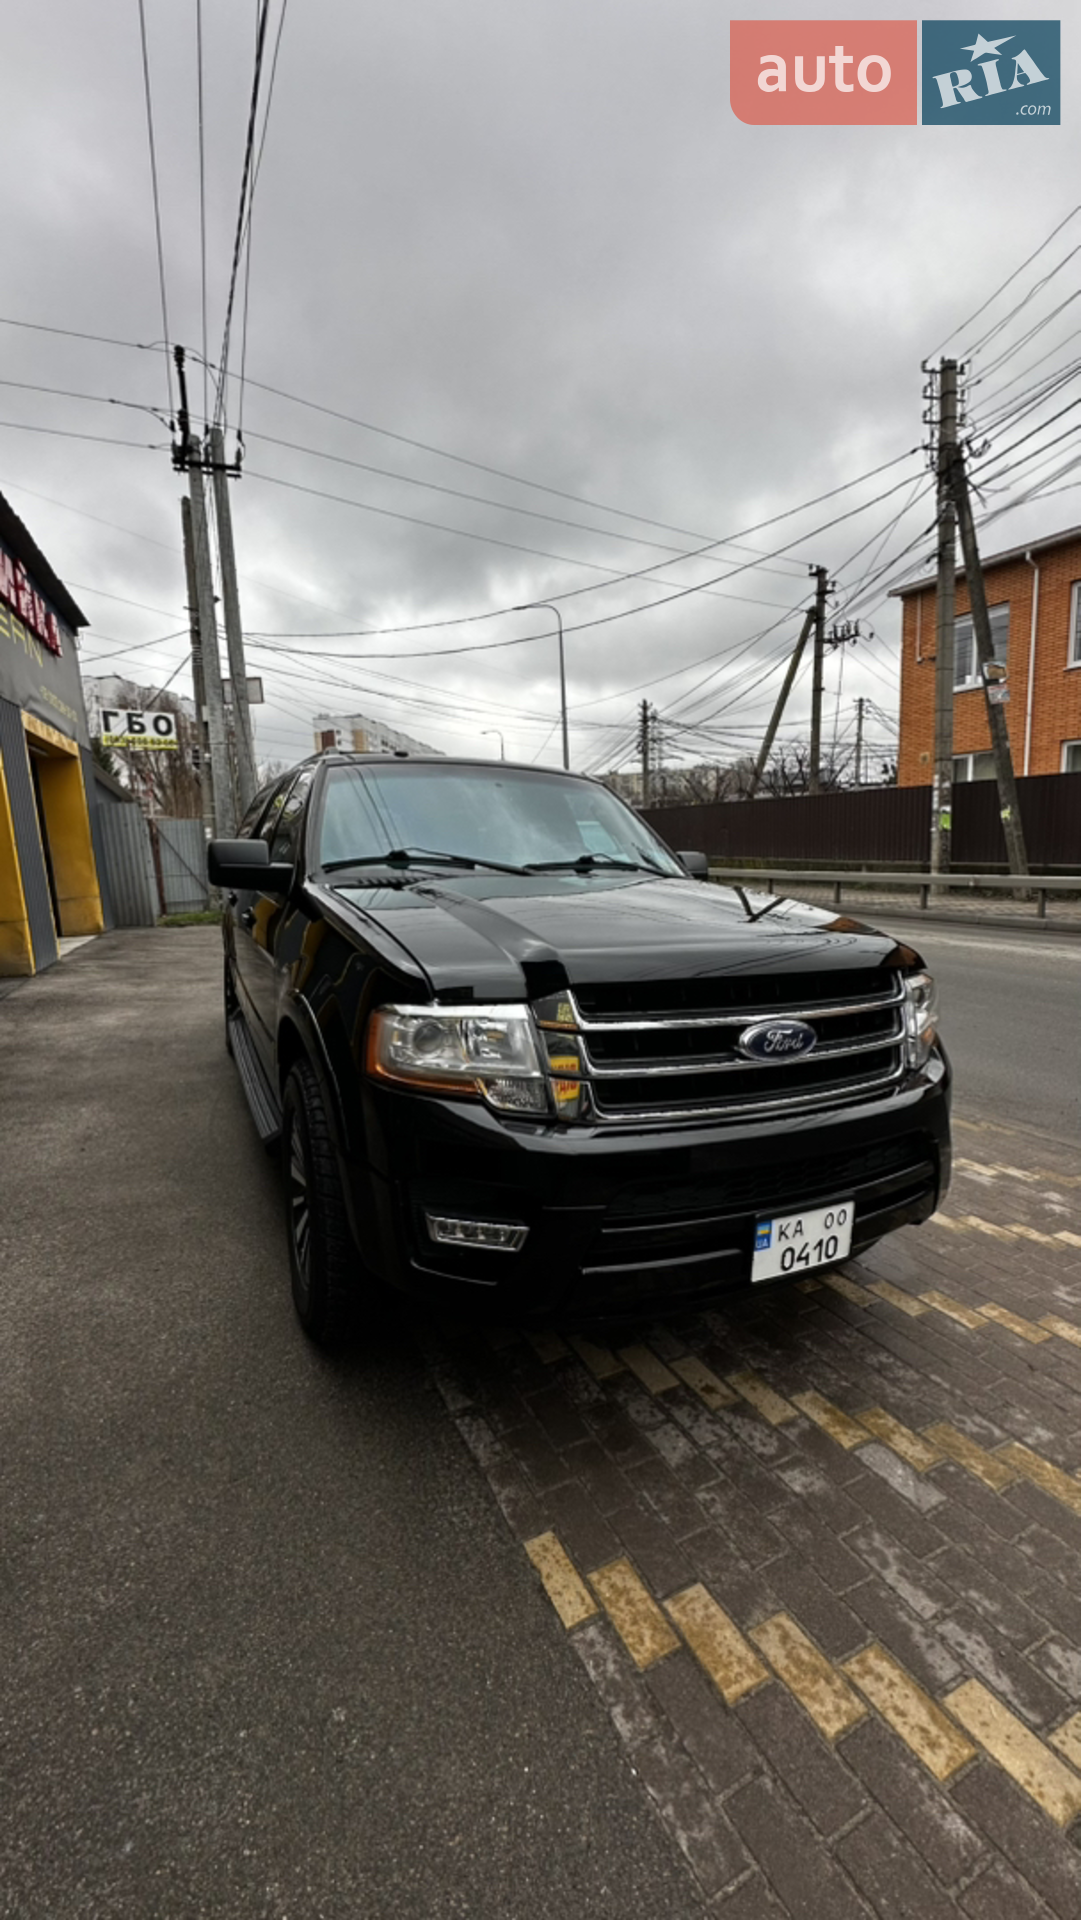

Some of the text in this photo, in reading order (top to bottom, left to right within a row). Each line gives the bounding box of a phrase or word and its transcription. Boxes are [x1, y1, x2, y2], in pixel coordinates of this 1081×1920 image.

[102, 710, 173, 737] ГБО
[763, 1029, 804, 1053] Ford
[778, 1208, 848, 1242] KA 00
[780, 1235, 839, 1272] 0410
